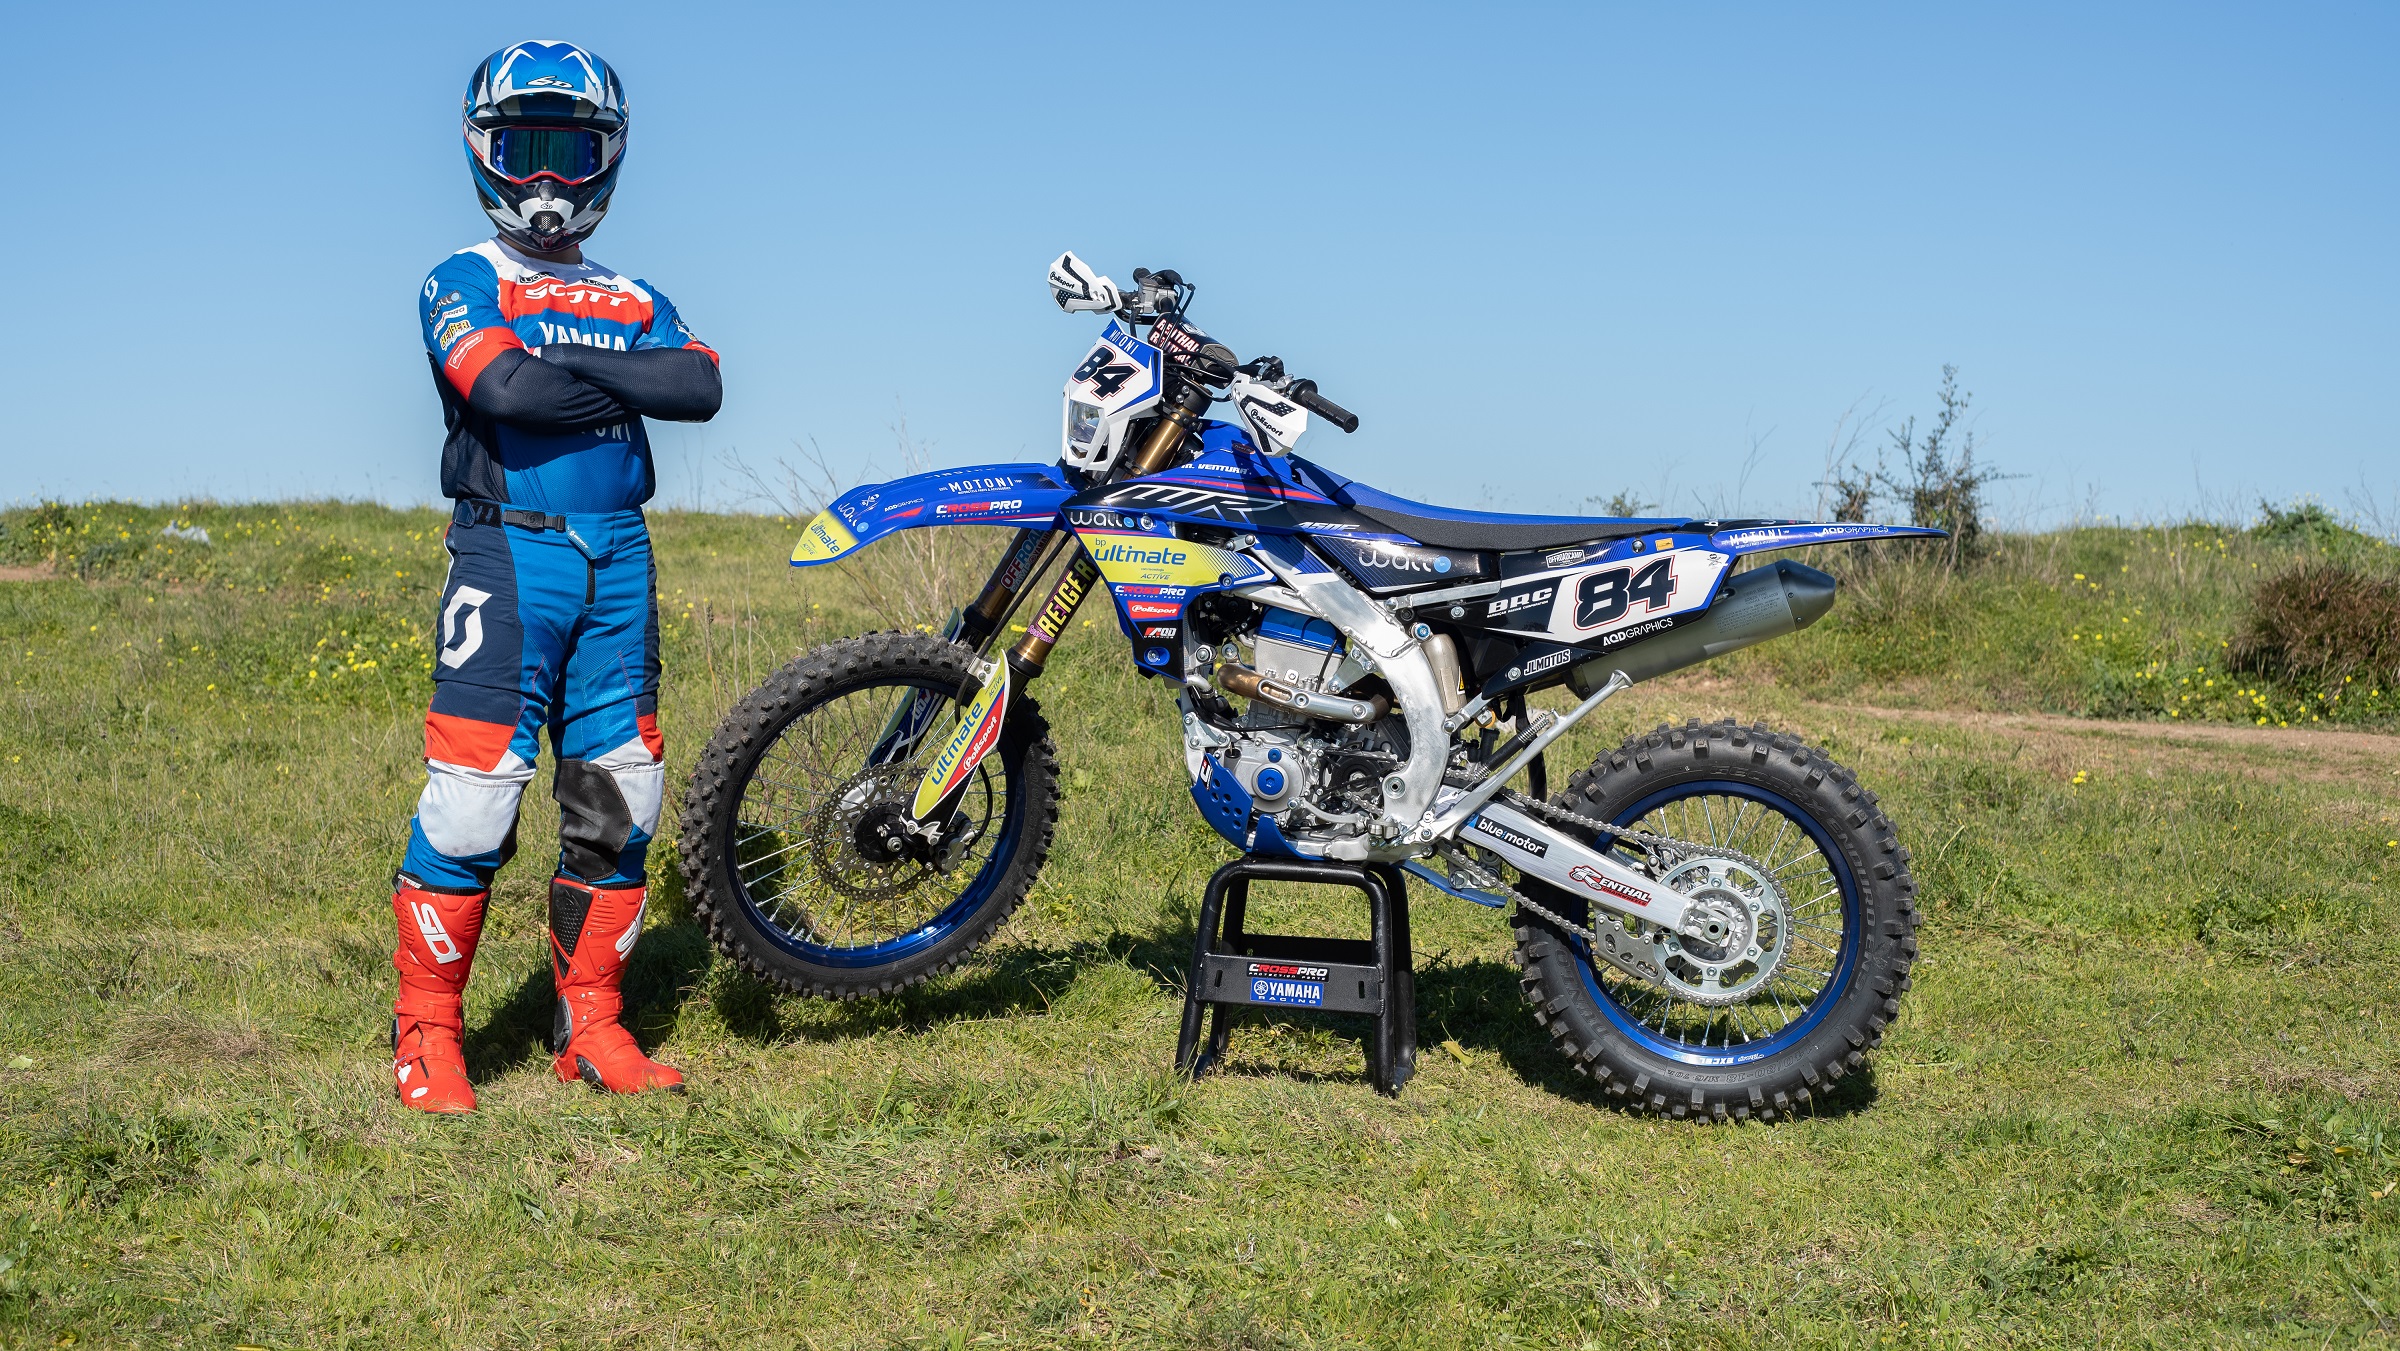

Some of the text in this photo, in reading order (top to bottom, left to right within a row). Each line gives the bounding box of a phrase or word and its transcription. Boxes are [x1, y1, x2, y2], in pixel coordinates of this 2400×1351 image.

[1050, 271, 1075, 289] Polisport
[1072, 345, 1140, 400] 84
[1250, 408, 1283, 437] Polisport
[1198, 464, 1248, 474] VENTURA
[948, 477, 1014, 493] MOTONI
[936, 499, 1022, 514] CROSSPRO
[1730, 528, 1782, 547] MOTONI
[1822, 525, 1889, 535] AQDGRAPHICS
[1095, 538, 1106, 547] bp
[1094, 544, 1187, 565] ultimate
[1037, 558, 1097, 638] REIGER
[1115, 585, 1187, 596] CROSSPRO
[1488, 587, 1553, 614] BRC
[1574, 555, 1678, 631] 84
[1132, 604, 1177, 614] Polisport
[1603, 617, 1674, 646] AQDGRAPHICS
[1524, 649, 1571, 676] JLMOTOS
[931, 702, 983, 785] ultimate
[963, 716, 998, 771] Polisport
[1828, 818, 1877, 927] ENDURO
[1248, 963, 1328, 977] CROSSPRO
[1258, 995, 1316, 1004] RACING
[1269, 982, 1320, 999] YAMAHA
[1556, 948, 1611, 1043] DUNLO
